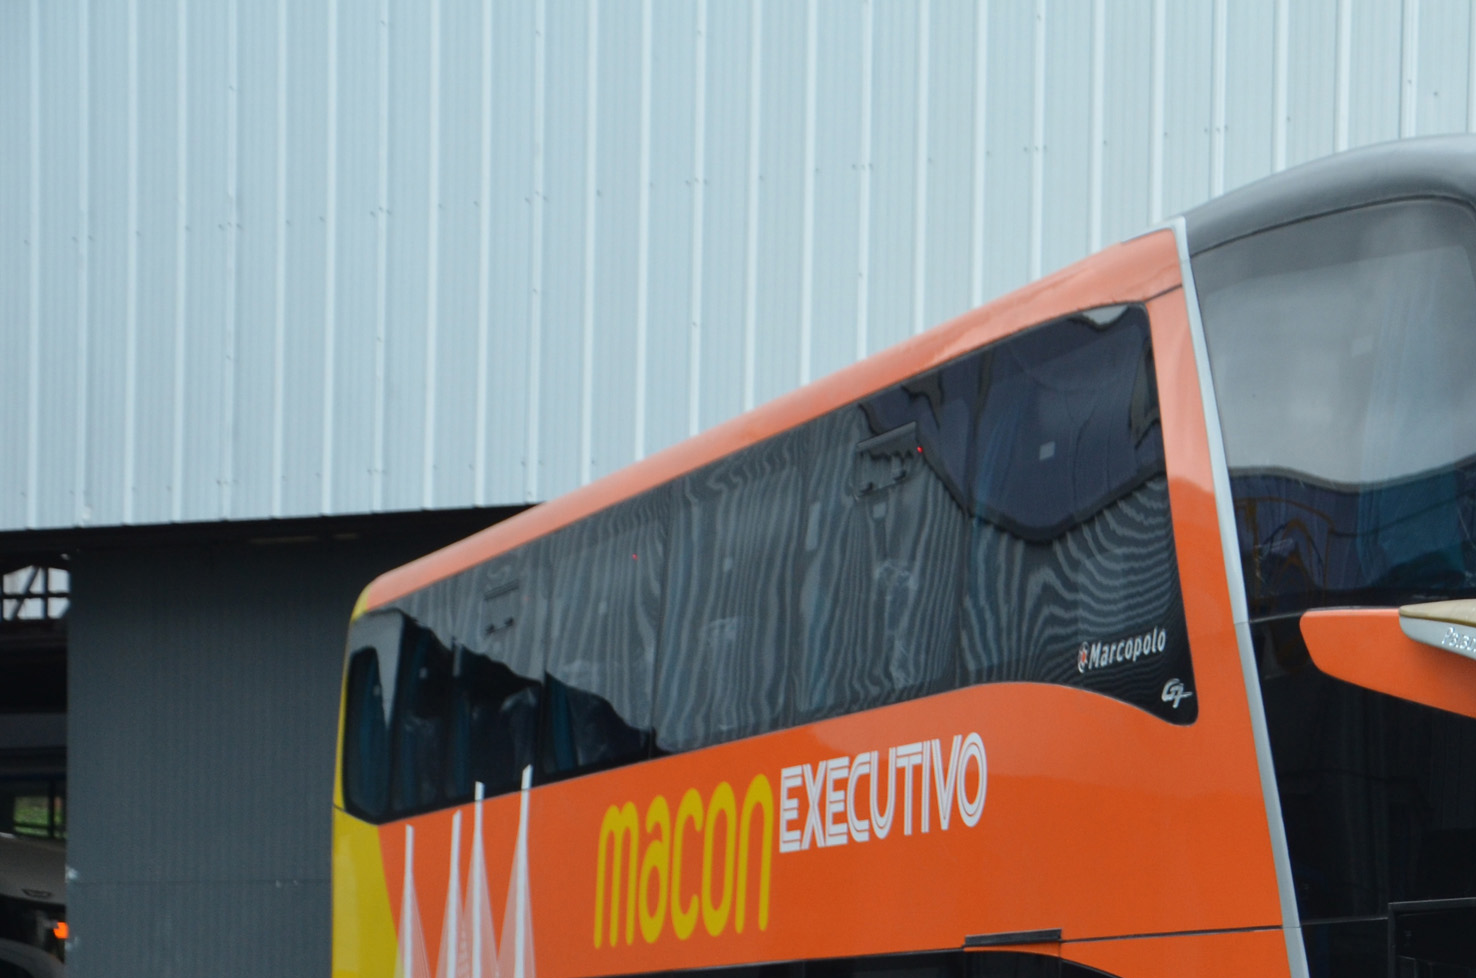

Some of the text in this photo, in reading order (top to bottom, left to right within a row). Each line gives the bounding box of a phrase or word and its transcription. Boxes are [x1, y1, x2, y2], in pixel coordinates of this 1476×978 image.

[1088, 626, 1166, 670] Marcopolo
[779, 732, 988, 853] EXECUTIVO
[593, 773, 774, 949] macon
